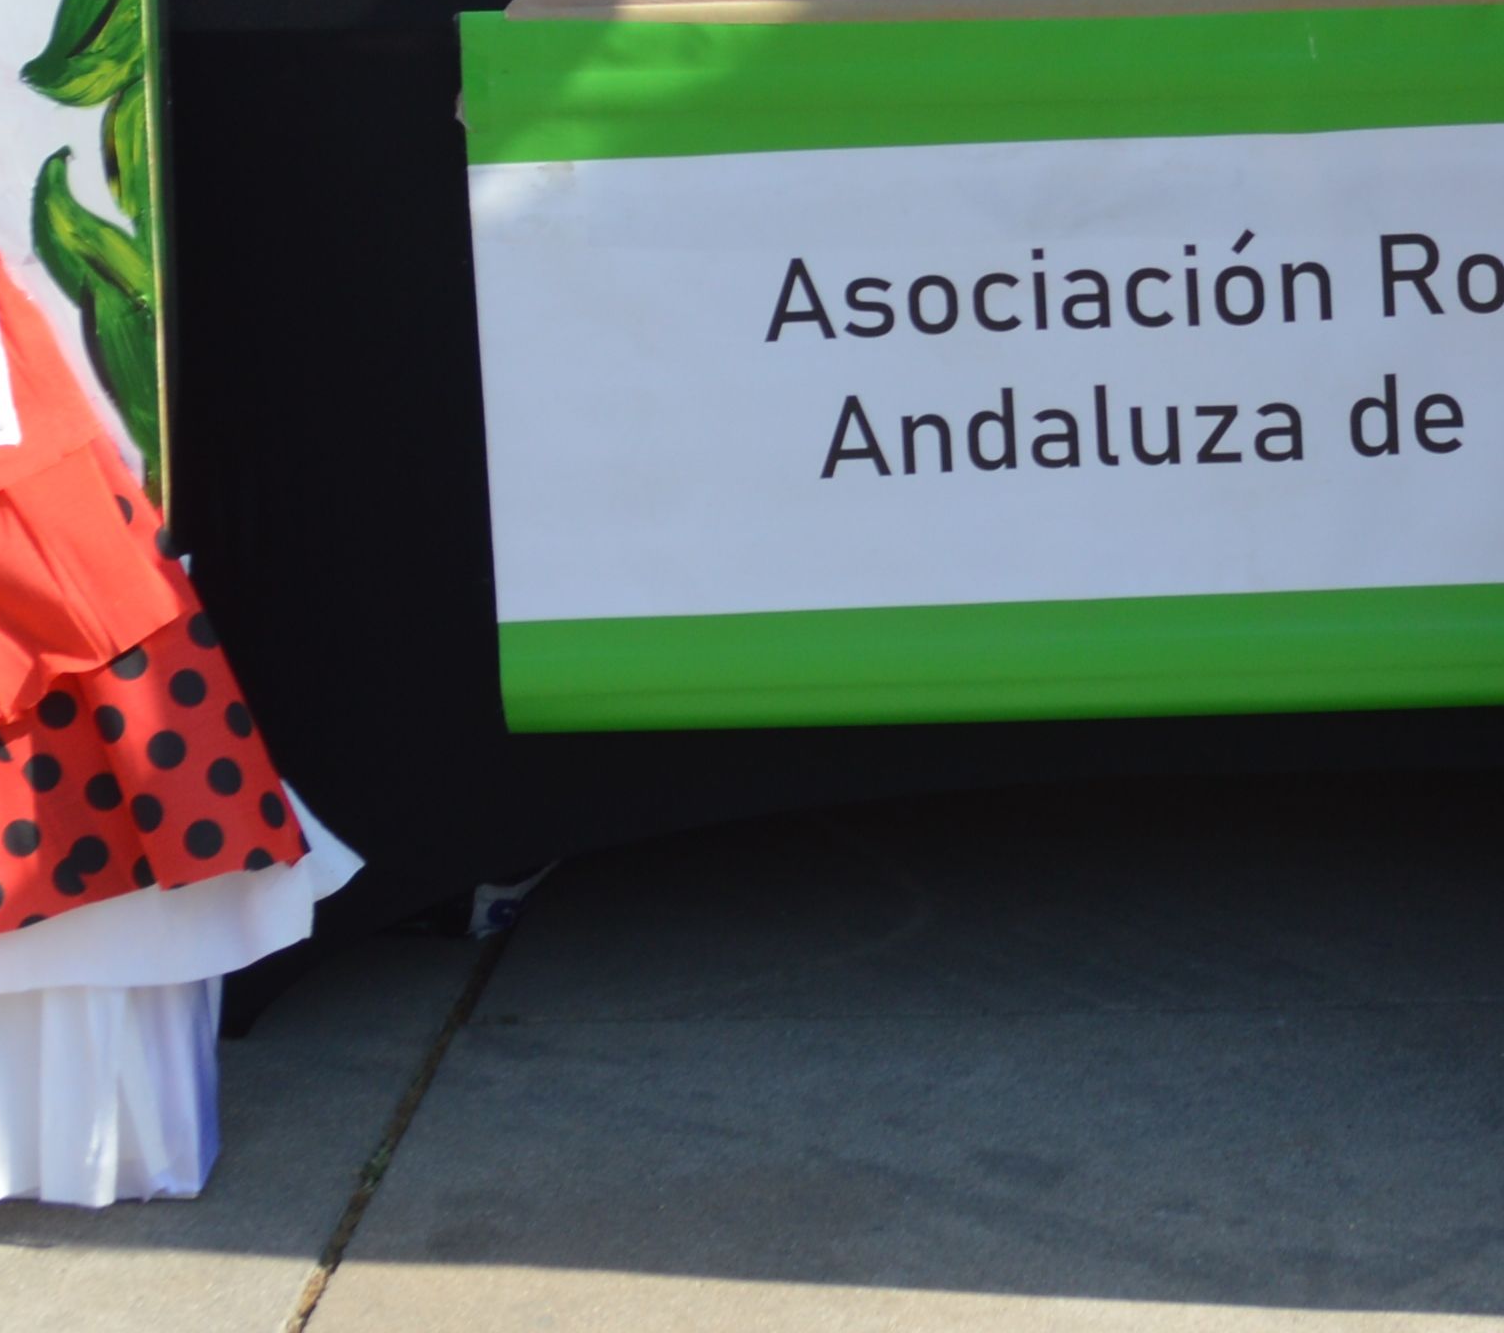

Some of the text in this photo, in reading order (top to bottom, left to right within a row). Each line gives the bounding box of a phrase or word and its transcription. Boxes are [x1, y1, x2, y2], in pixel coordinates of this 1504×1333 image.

[766, 229, 1334, 342] Asociación
[820, 373, 1304, 479] Andaluza
[1348, 371, 1467, 457] de
